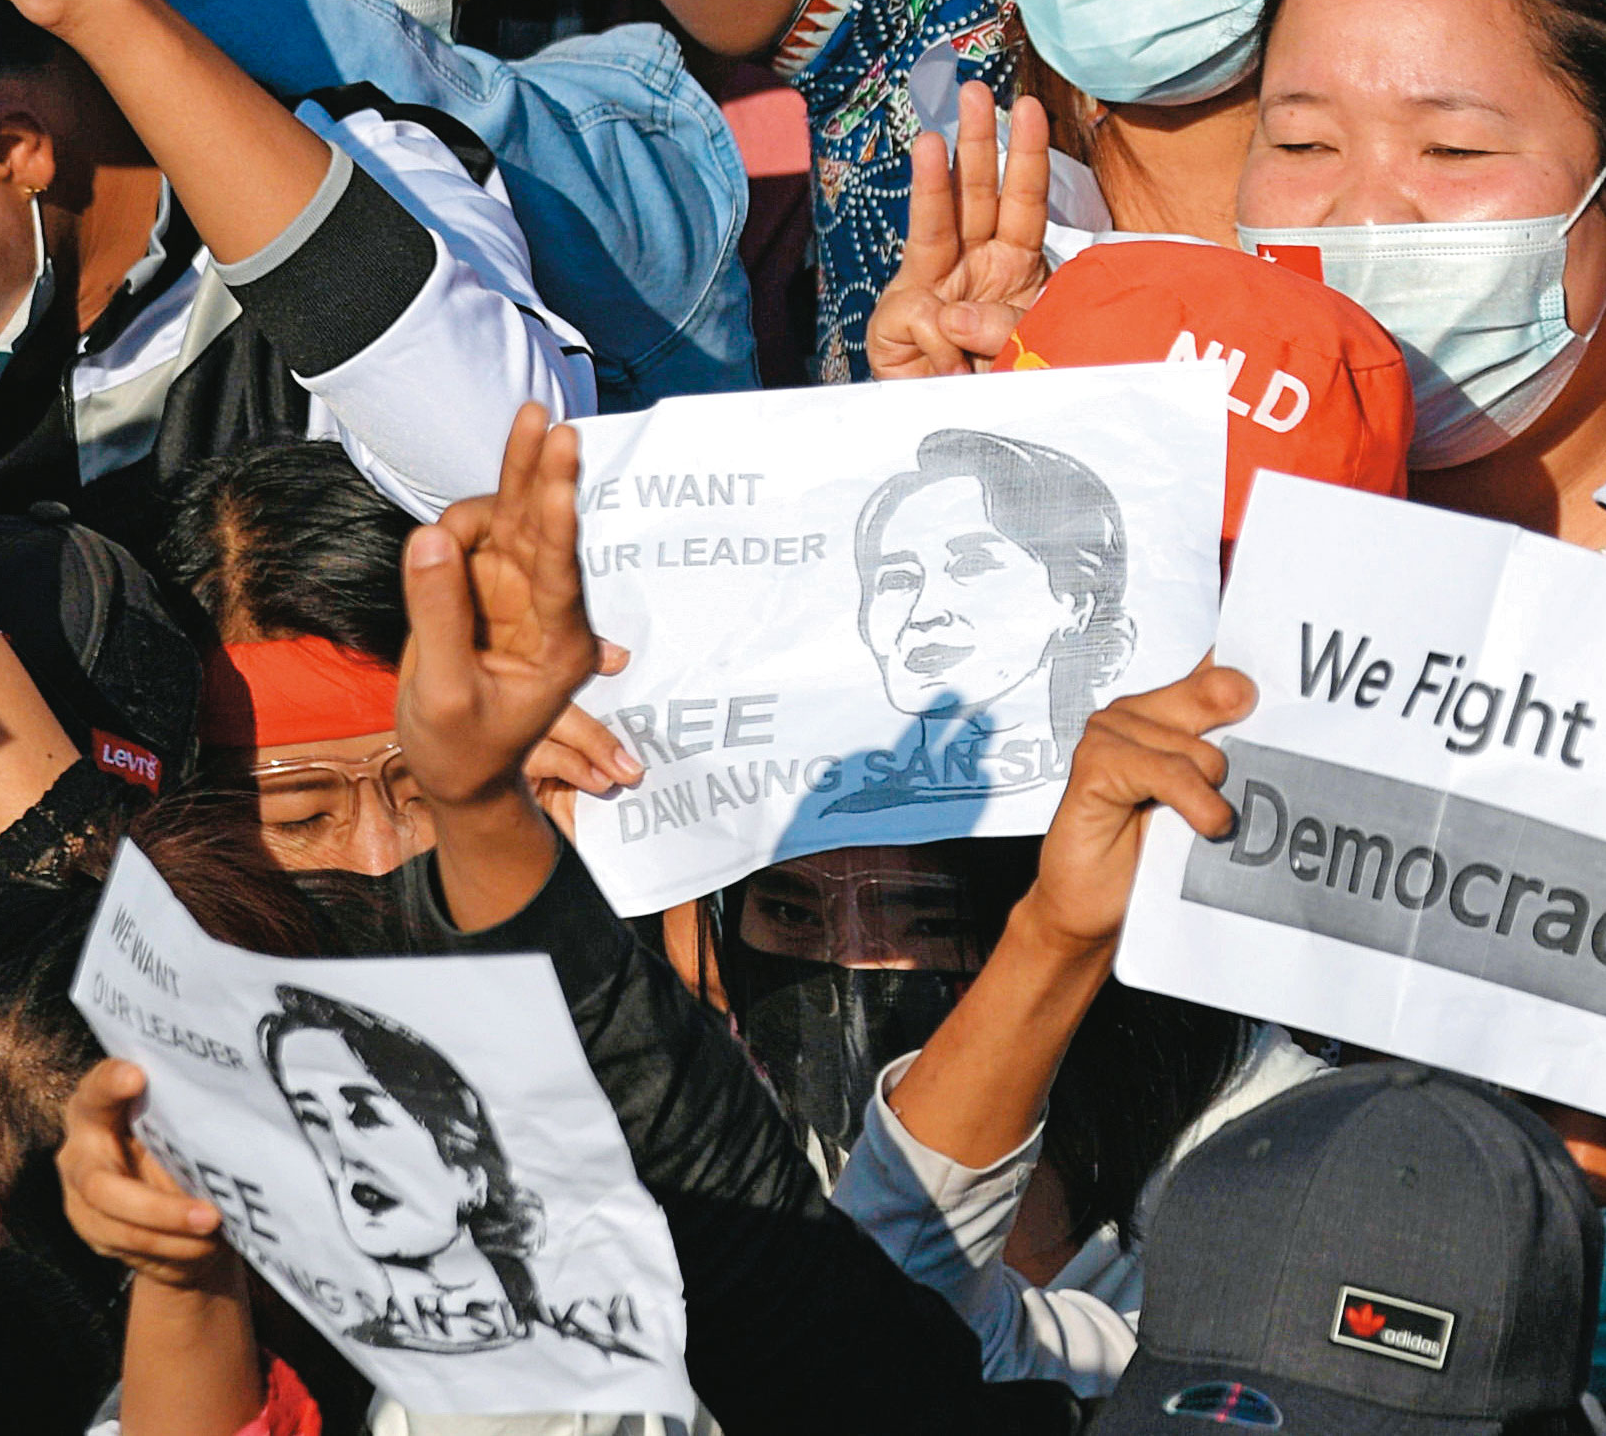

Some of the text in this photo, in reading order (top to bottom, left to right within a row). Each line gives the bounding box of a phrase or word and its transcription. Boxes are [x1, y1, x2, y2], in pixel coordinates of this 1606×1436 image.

[1165, 328, 1311, 435] NLD
[637, 474, 765, 507] WANT
[588, 533, 826, 577] UR LEADER
[1298, 622, 1394, 709] We
[1402, 650, 1596, 772] Fight
[617, 777, 699, 843] DAW
[707, 755, 843, 816] AUNG
[864, 746, 981, 785] SAN
[110, 903, 182, 999] WE WANT
[94, 971, 248, 1073] OUR LEADER
[1380, 1329, 1440, 1357] adidas
